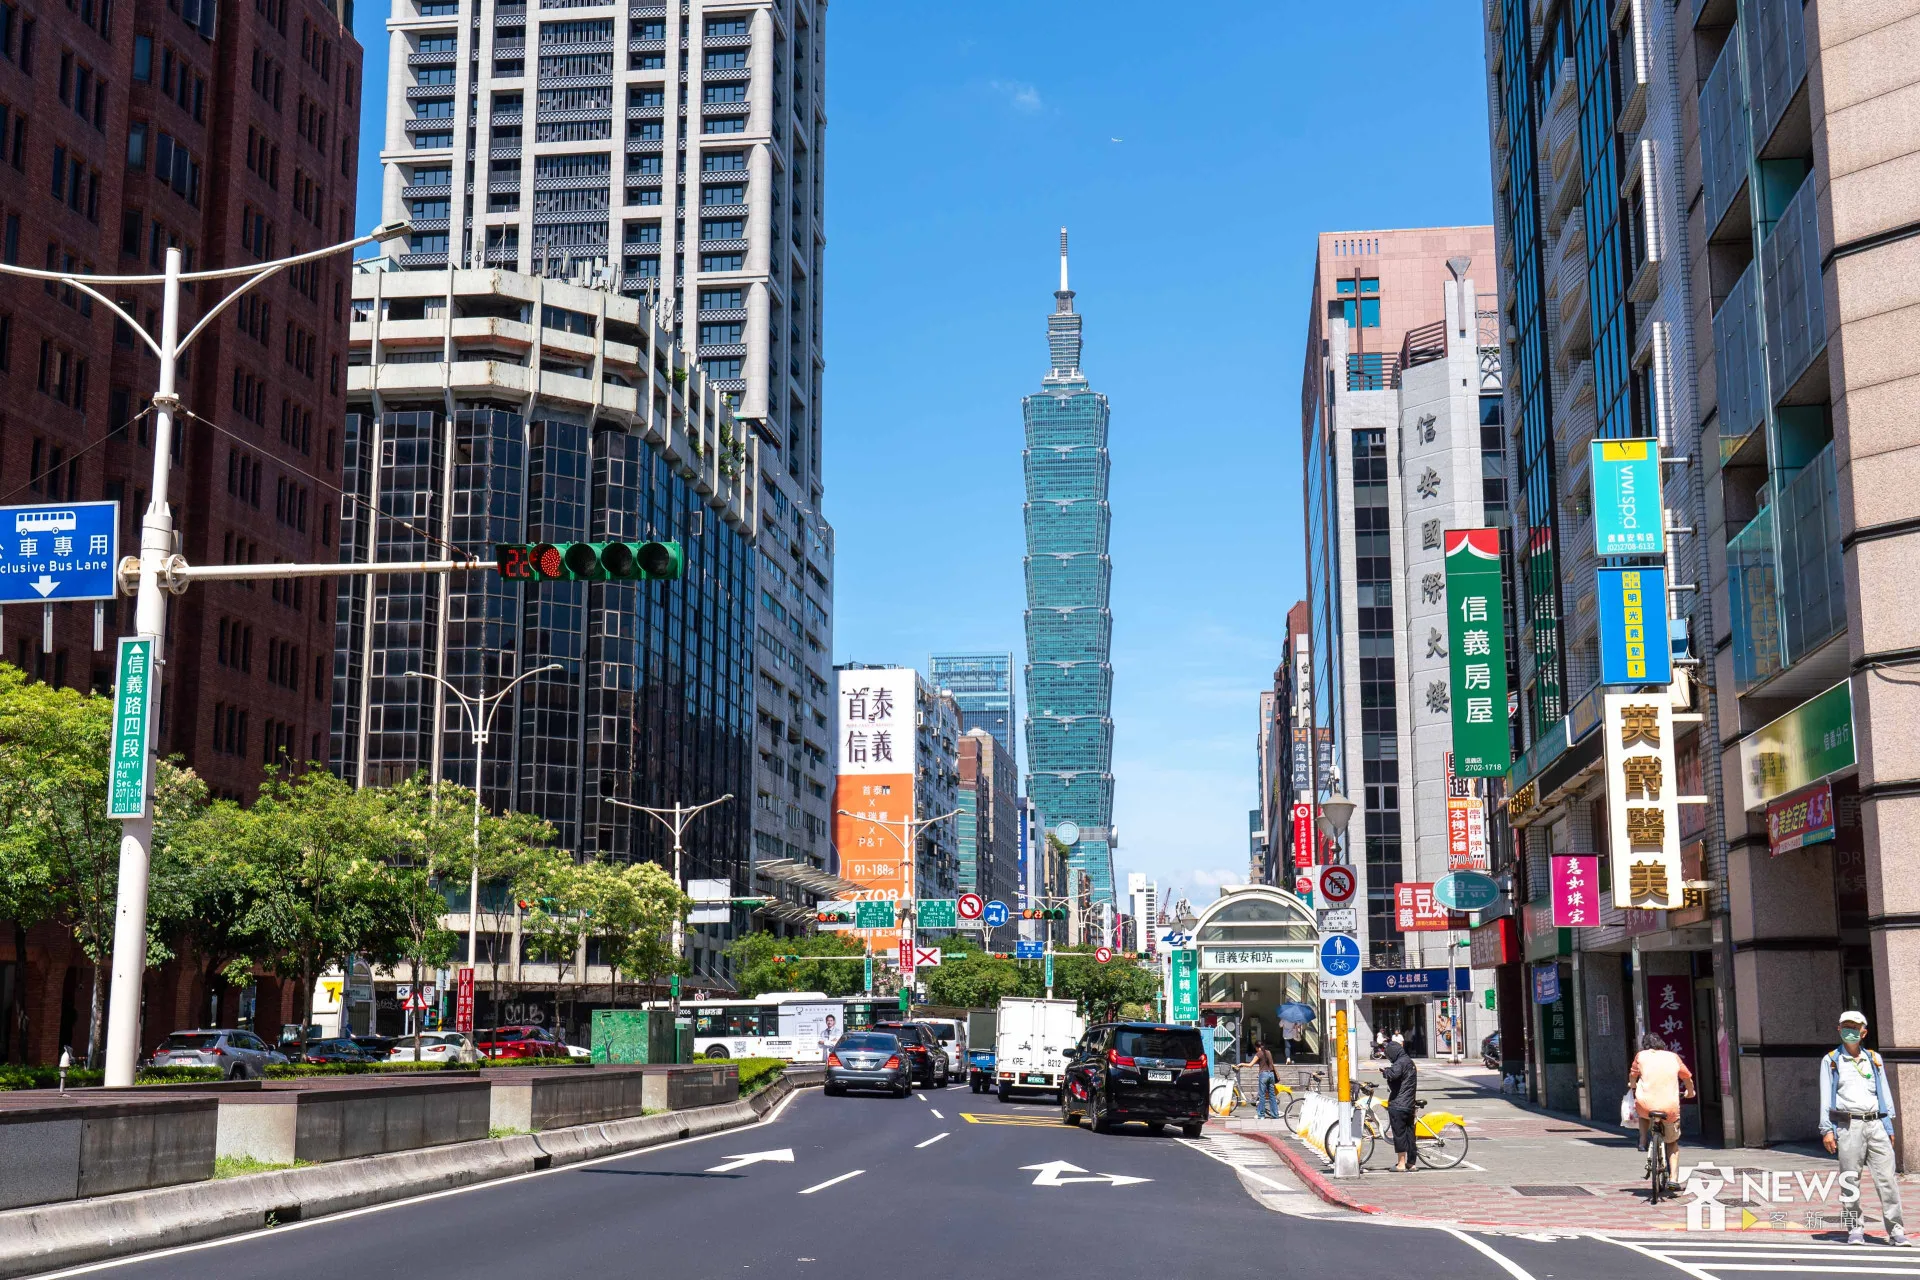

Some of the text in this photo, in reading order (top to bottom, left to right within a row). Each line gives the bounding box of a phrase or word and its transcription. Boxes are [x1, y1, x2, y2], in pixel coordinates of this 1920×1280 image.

[0, 535, 108, 559] 車專用
[49, 560, 73, 572] Bus
[76, 560, 108, 571] Lane
[1416, 413, 1450, 715] 信安國際大樓
[1460, 596, 1494, 724] 信義房屋
[121, 655, 145, 758] 信義路四段
[846, 687, 893, 720] 首泰
[846, 730, 893, 763] 信義
[117, 761, 139, 769] XinYi
[1464, 764, 1502, 772] 2702-1718
[116, 770, 129, 779] Rd.
[116, 779, 134, 788] Sec.
[115, 788, 141, 797] 207 216
[114, 803, 126, 812] 203
[1620, 703, 1670, 906] 英爵醫美
[1398, 887, 1414, 927] 信義
[1215, 951, 1273, 964] 信義安和站
[1321, 980, 1360, 989] 行人優先
[1174, 1005, 1197, 1013] U-turn
[1047, 1059, 1061, 1068] 8212
